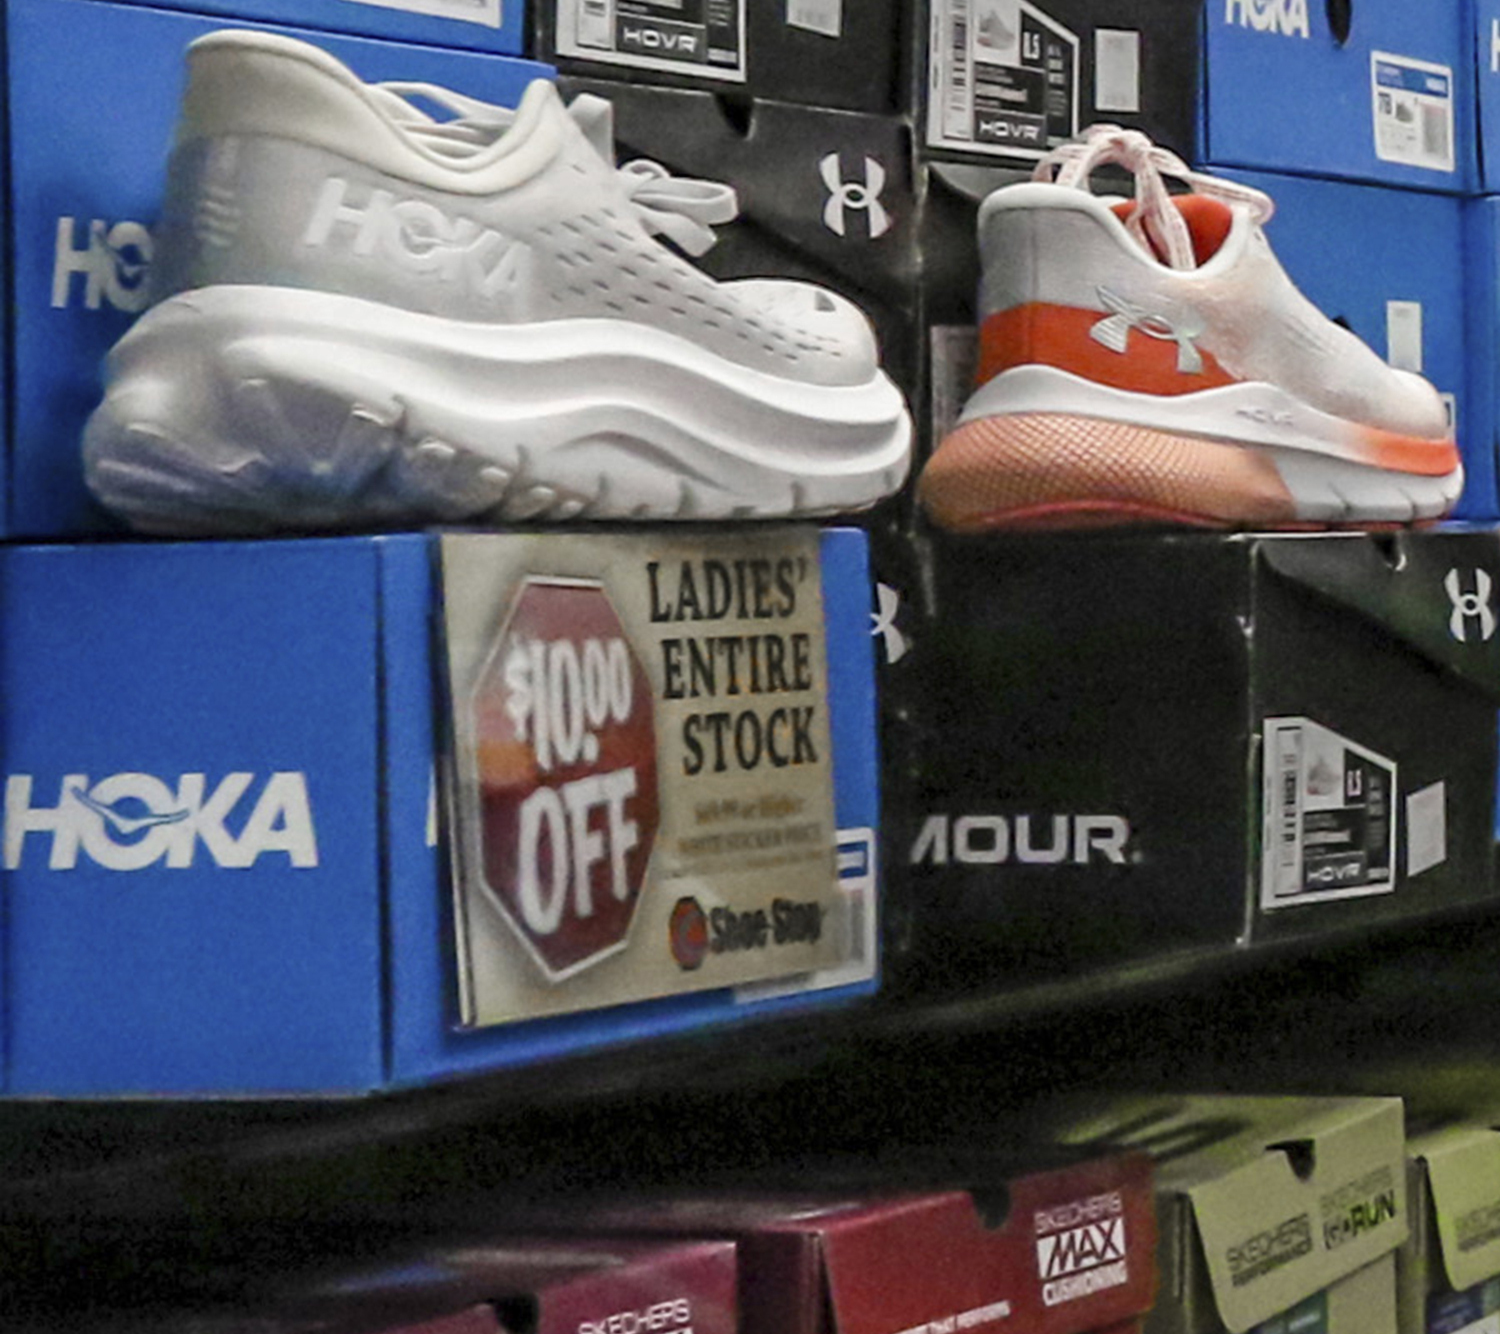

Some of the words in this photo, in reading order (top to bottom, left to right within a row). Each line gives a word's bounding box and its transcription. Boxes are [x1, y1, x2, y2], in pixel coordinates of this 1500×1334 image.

[621, 25, 699, 55] HOVR
[980, 119, 1040, 143] HOVR
[51, 216, 153, 311] HO
[304, 177, 532, 299] HOKA
[646, 556, 807, 624] LADIES'
[660, 632, 813, 701] ENTIRE
[504, 634, 634, 771] $10.00
[683, 705, 821, 776] STOCK
[5, 771, 319, 870] HOKA
[517, 767, 640, 935] OFF
[1307, 861, 1362, 885] HOVR
[1041, 1215, 1124, 1280] MAX
